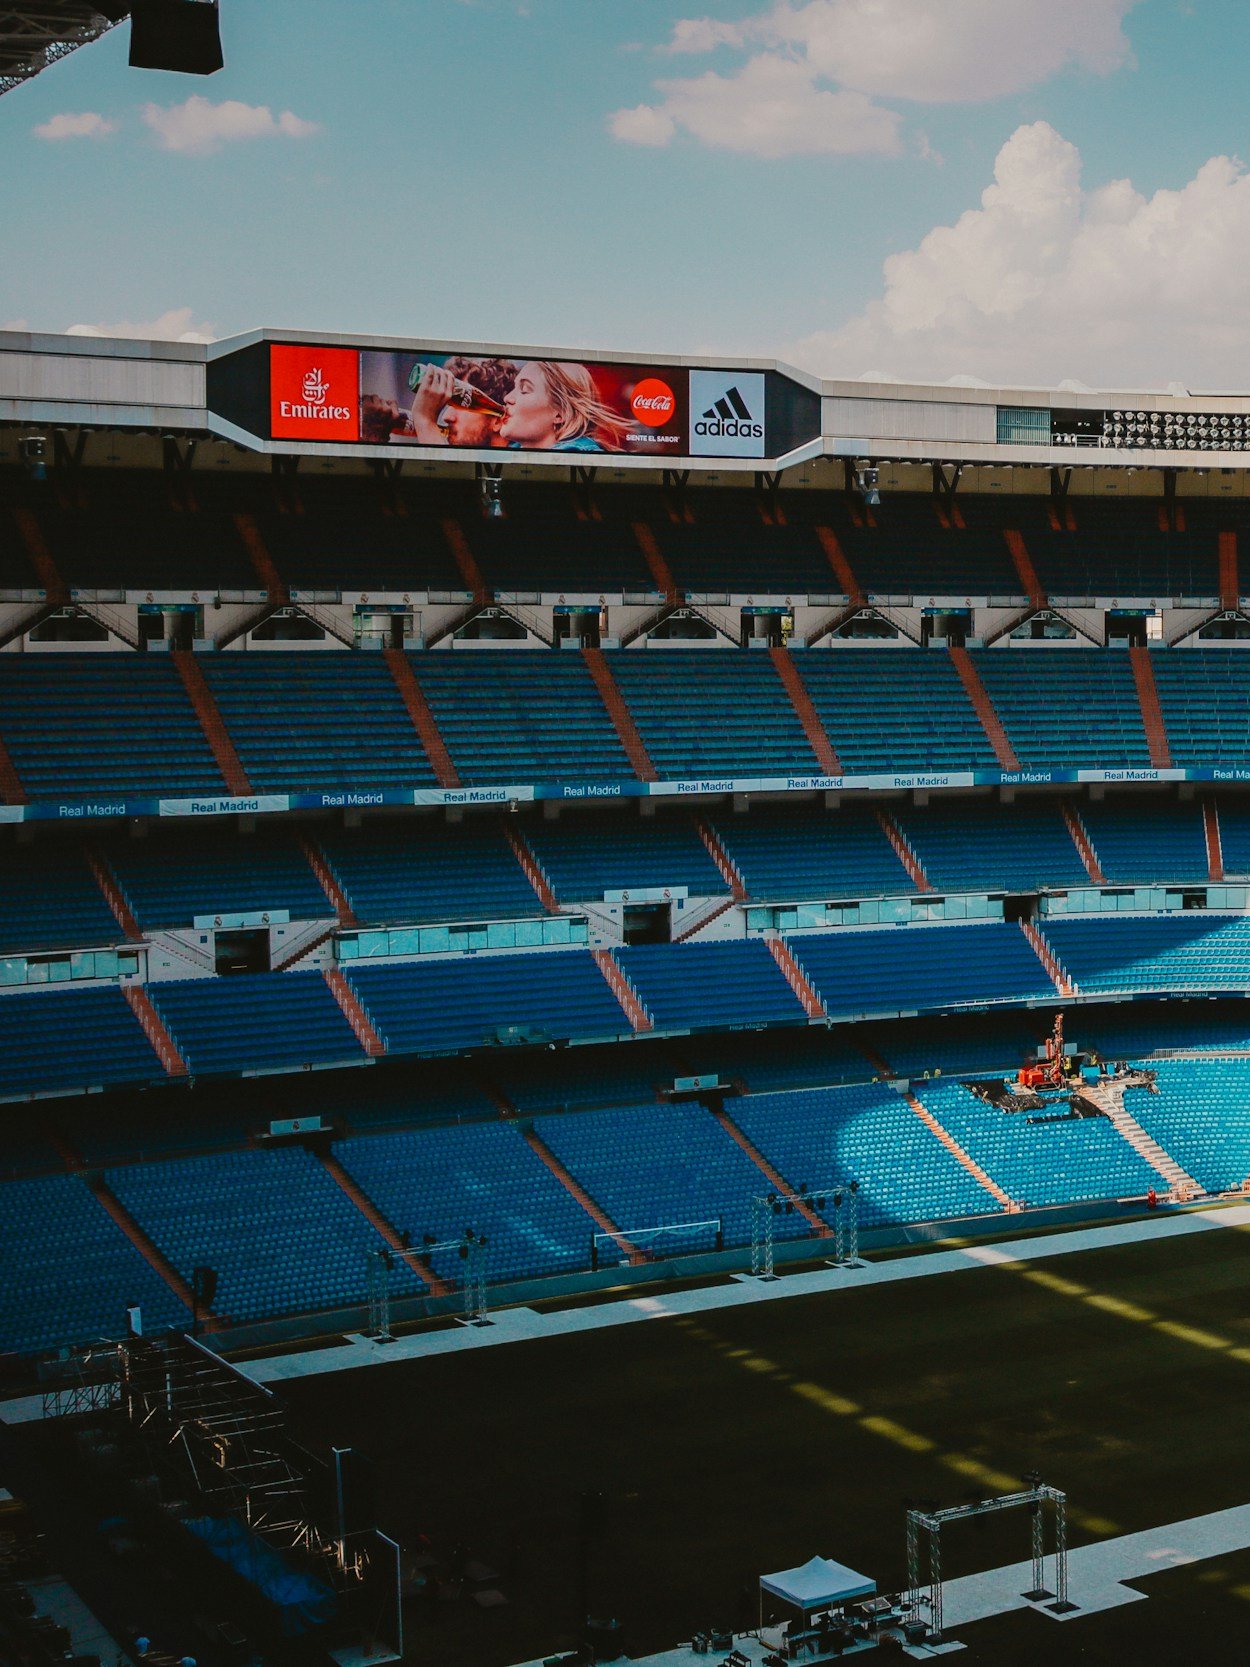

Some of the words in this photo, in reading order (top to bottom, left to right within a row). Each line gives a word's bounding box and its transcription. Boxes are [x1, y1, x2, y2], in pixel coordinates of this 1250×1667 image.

[280, 401, 350, 420] Emirates
[694, 418, 763, 438] adidas
[626, 434, 648, 442] SIENTE
[1001, 773, 1020, 783] Real
[1022, 772, 1052, 782] Madrid
[1104, 771, 1125, 781] Real
[1127, 770, 1158, 780] Madrid
[1213, 770, 1234, 780] Real
[677, 781, 698, 792] Real
[701, 780, 733, 791] Madrid
[788, 778, 809, 789] Real
[811, 777, 843, 788] Madrid
[894, 777, 914, 788] Real
[917, 776, 948, 786] Madrid
[444, 792, 467, 803] Real
[470, 790, 506, 801] Madrid
[563, 786, 584, 797] Real
[586, 785, 621, 796] Madrid
[322, 794, 344, 805] Real
[347, 792, 383, 804] Madrid
[59, 805, 85, 817] Real
[88, 803, 126, 815] Madrid
[191, 801, 215, 814] Real
[219, 799, 259, 812] Madrid
